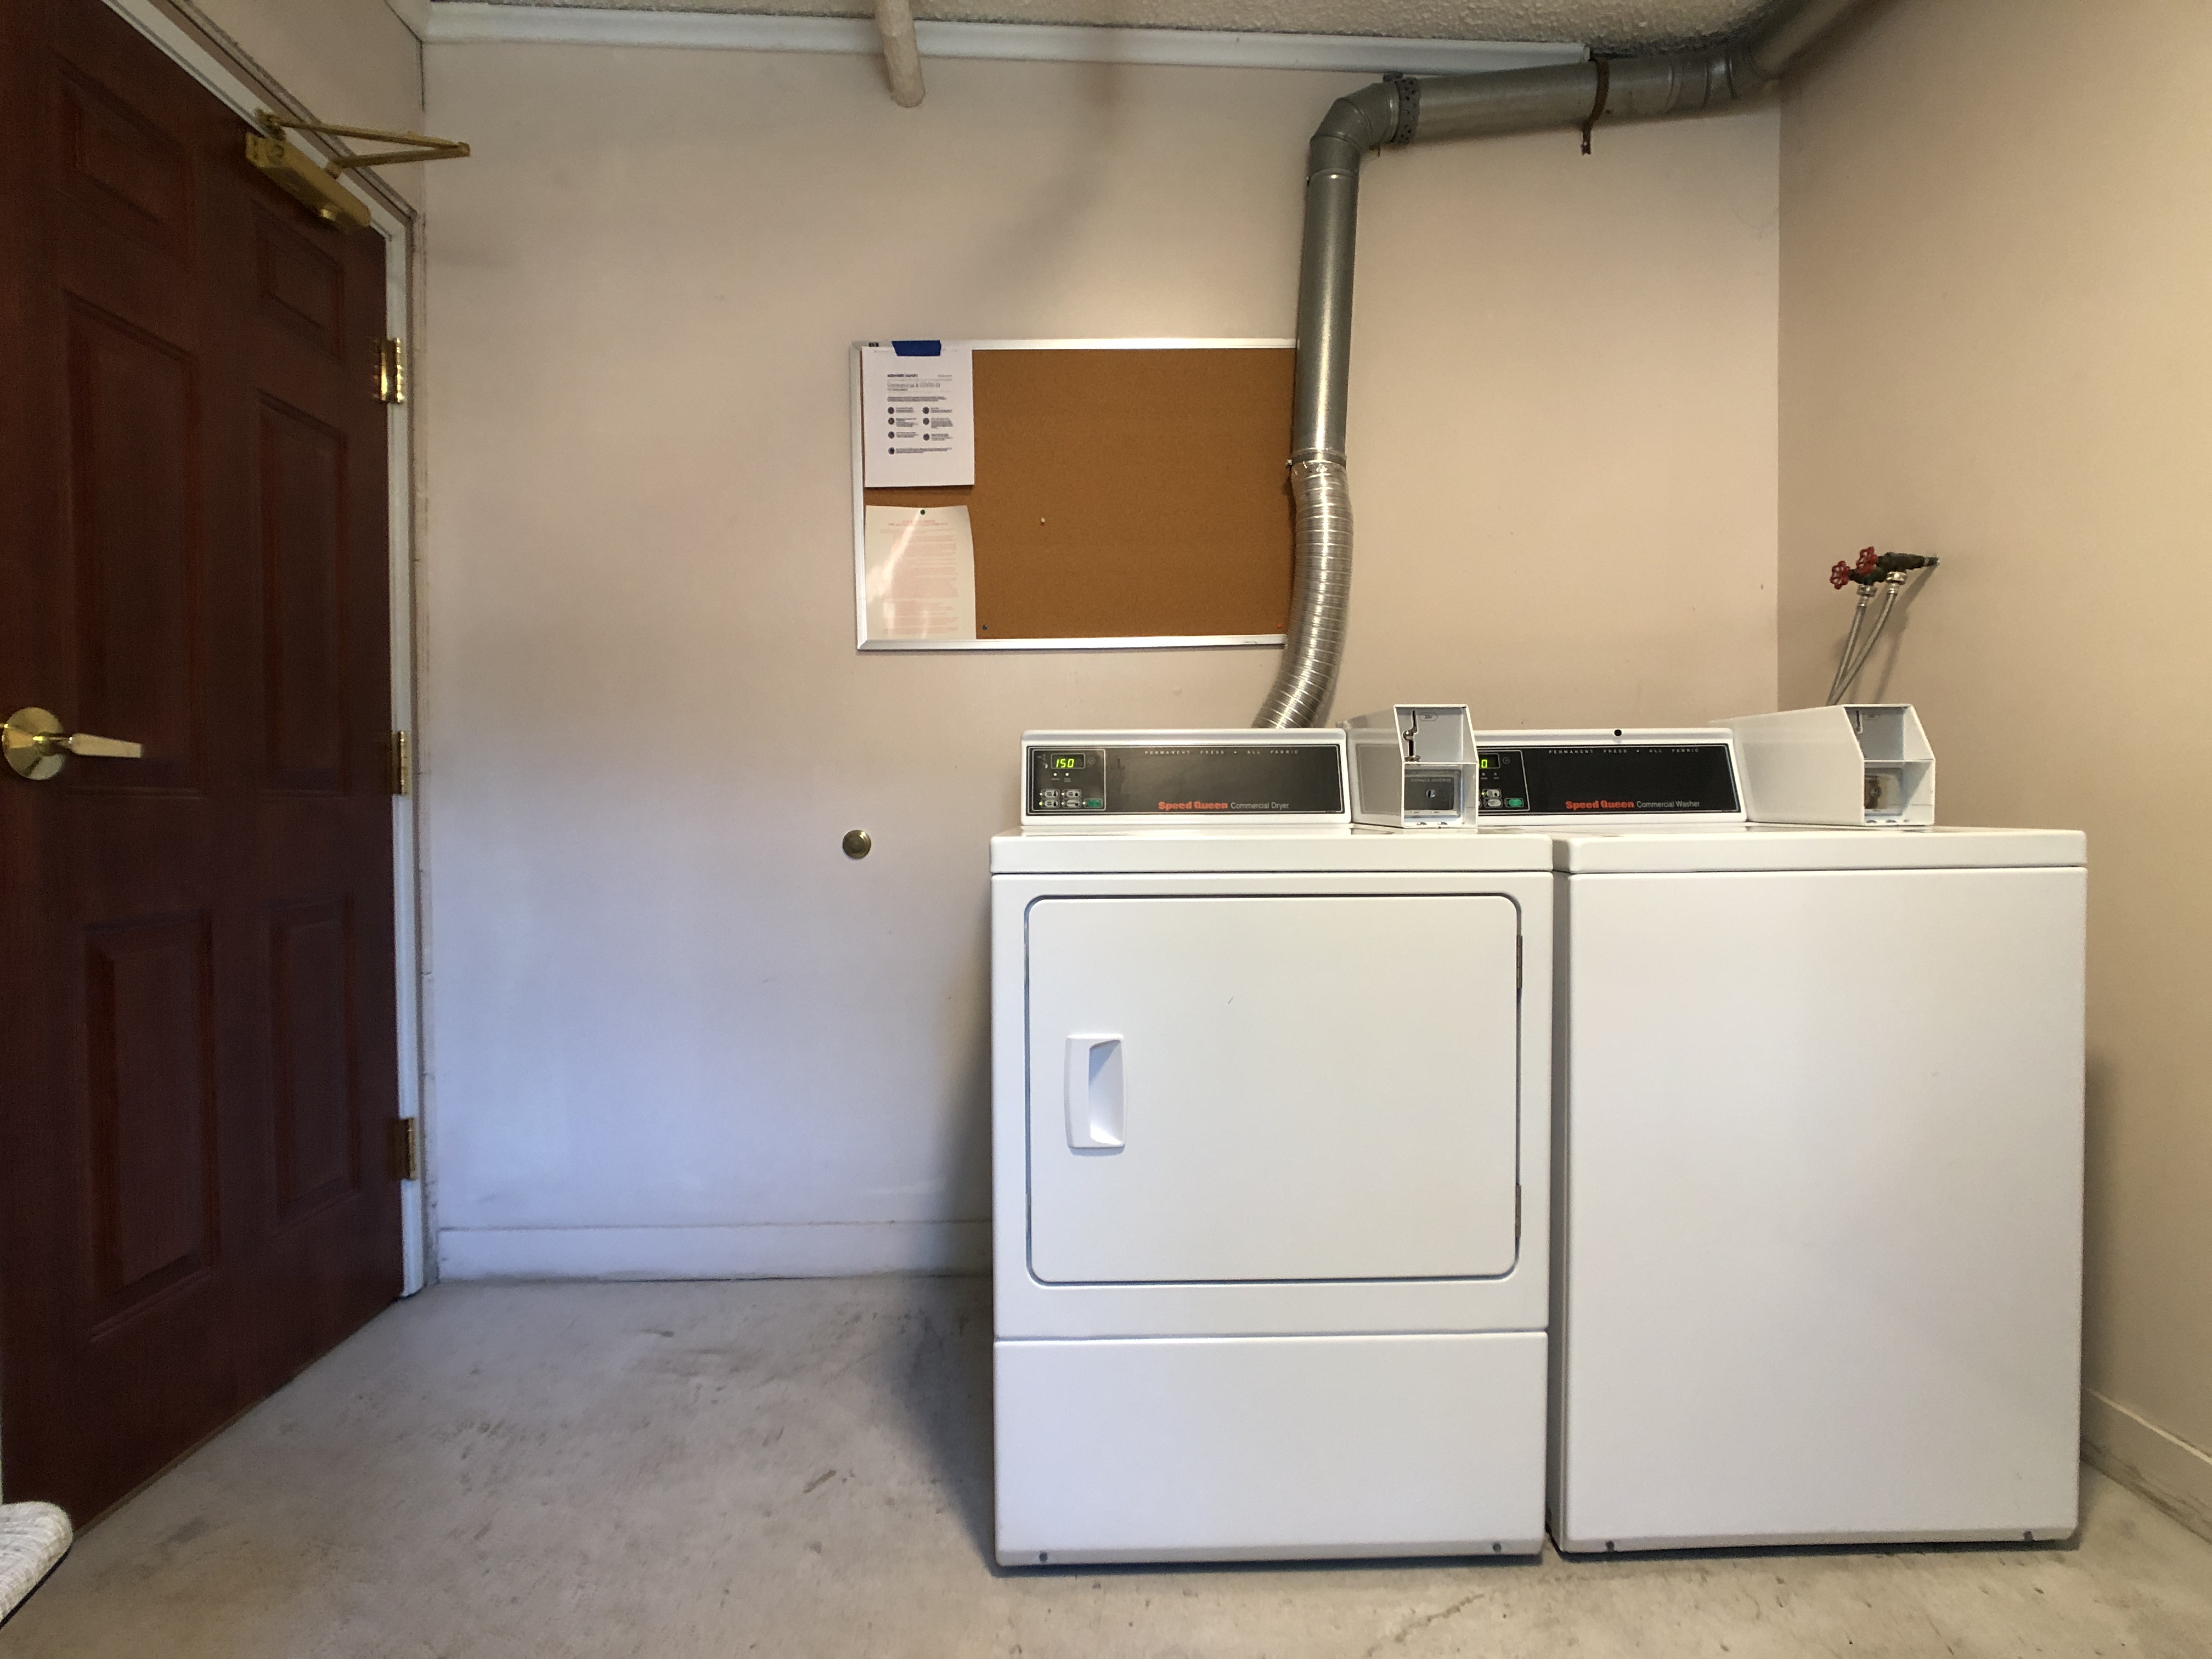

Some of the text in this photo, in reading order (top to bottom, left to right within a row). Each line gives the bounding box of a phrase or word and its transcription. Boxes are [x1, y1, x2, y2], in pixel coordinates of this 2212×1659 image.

[1056, 759, 1075, 768] 150
[1158, 801, 1193, 811] Speed
[1193, 801, 1228, 809] Queen
[1271, 802, 1290, 810] Dryer
[1565, 800, 1599, 810] Speed
[1600, 800, 1634, 809] Queen
